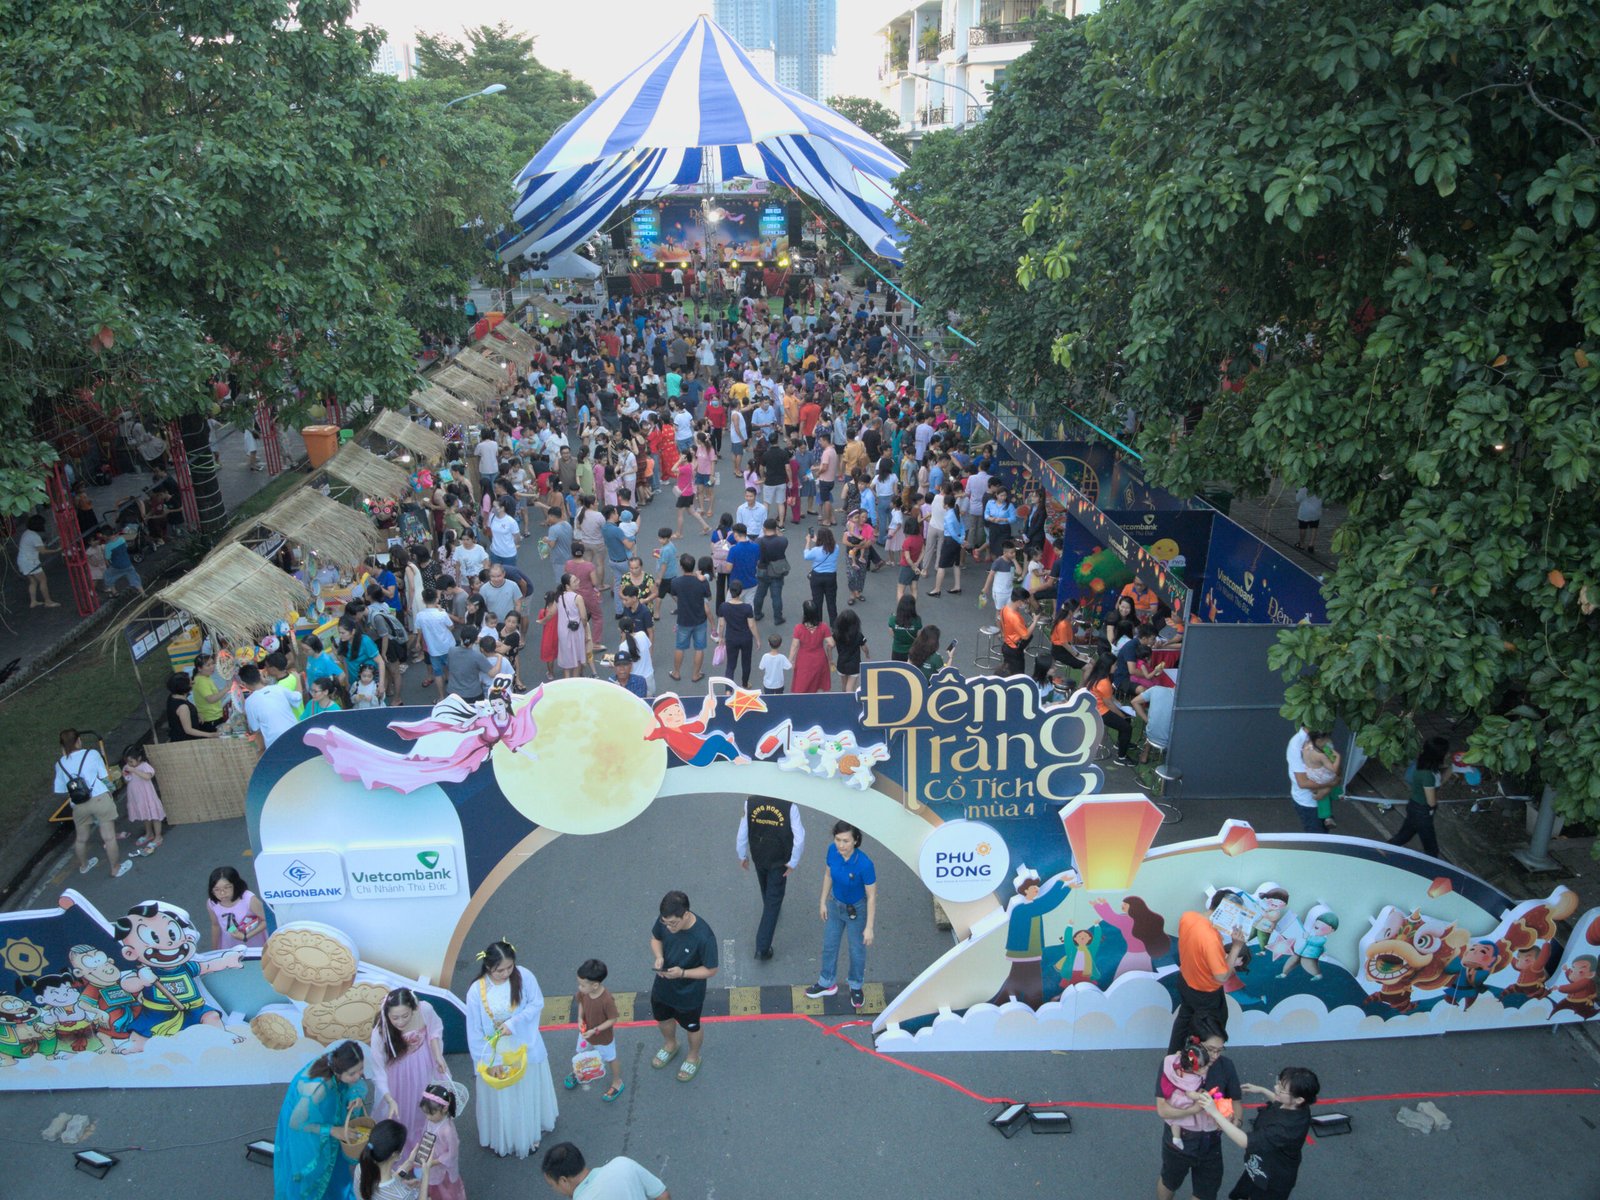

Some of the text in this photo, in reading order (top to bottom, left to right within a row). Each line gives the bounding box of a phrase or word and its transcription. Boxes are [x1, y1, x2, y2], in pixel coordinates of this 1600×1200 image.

[1218, 568, 1254, 606] Vietcombank
[860, 667, 1036, 727] Đêm
[889, 698, 1097, 810] Trăng
[924, 775, 1035, 801] Cổ Tích
[751, 805, 765, 818] LONG
[968, 801, 1035, 818] mùa 4
[936, 852, 974, 864] PHU
[352, 868, 452, 883] Vietcombank
[936, 864, 991, 878] DONG
[264, 887, 342, 899] SAIGONBANK
[356, 884, 371, 894] Chi
[374, 884, 404, 893] Nhánh
[428, 882, 447, 892] Đức
